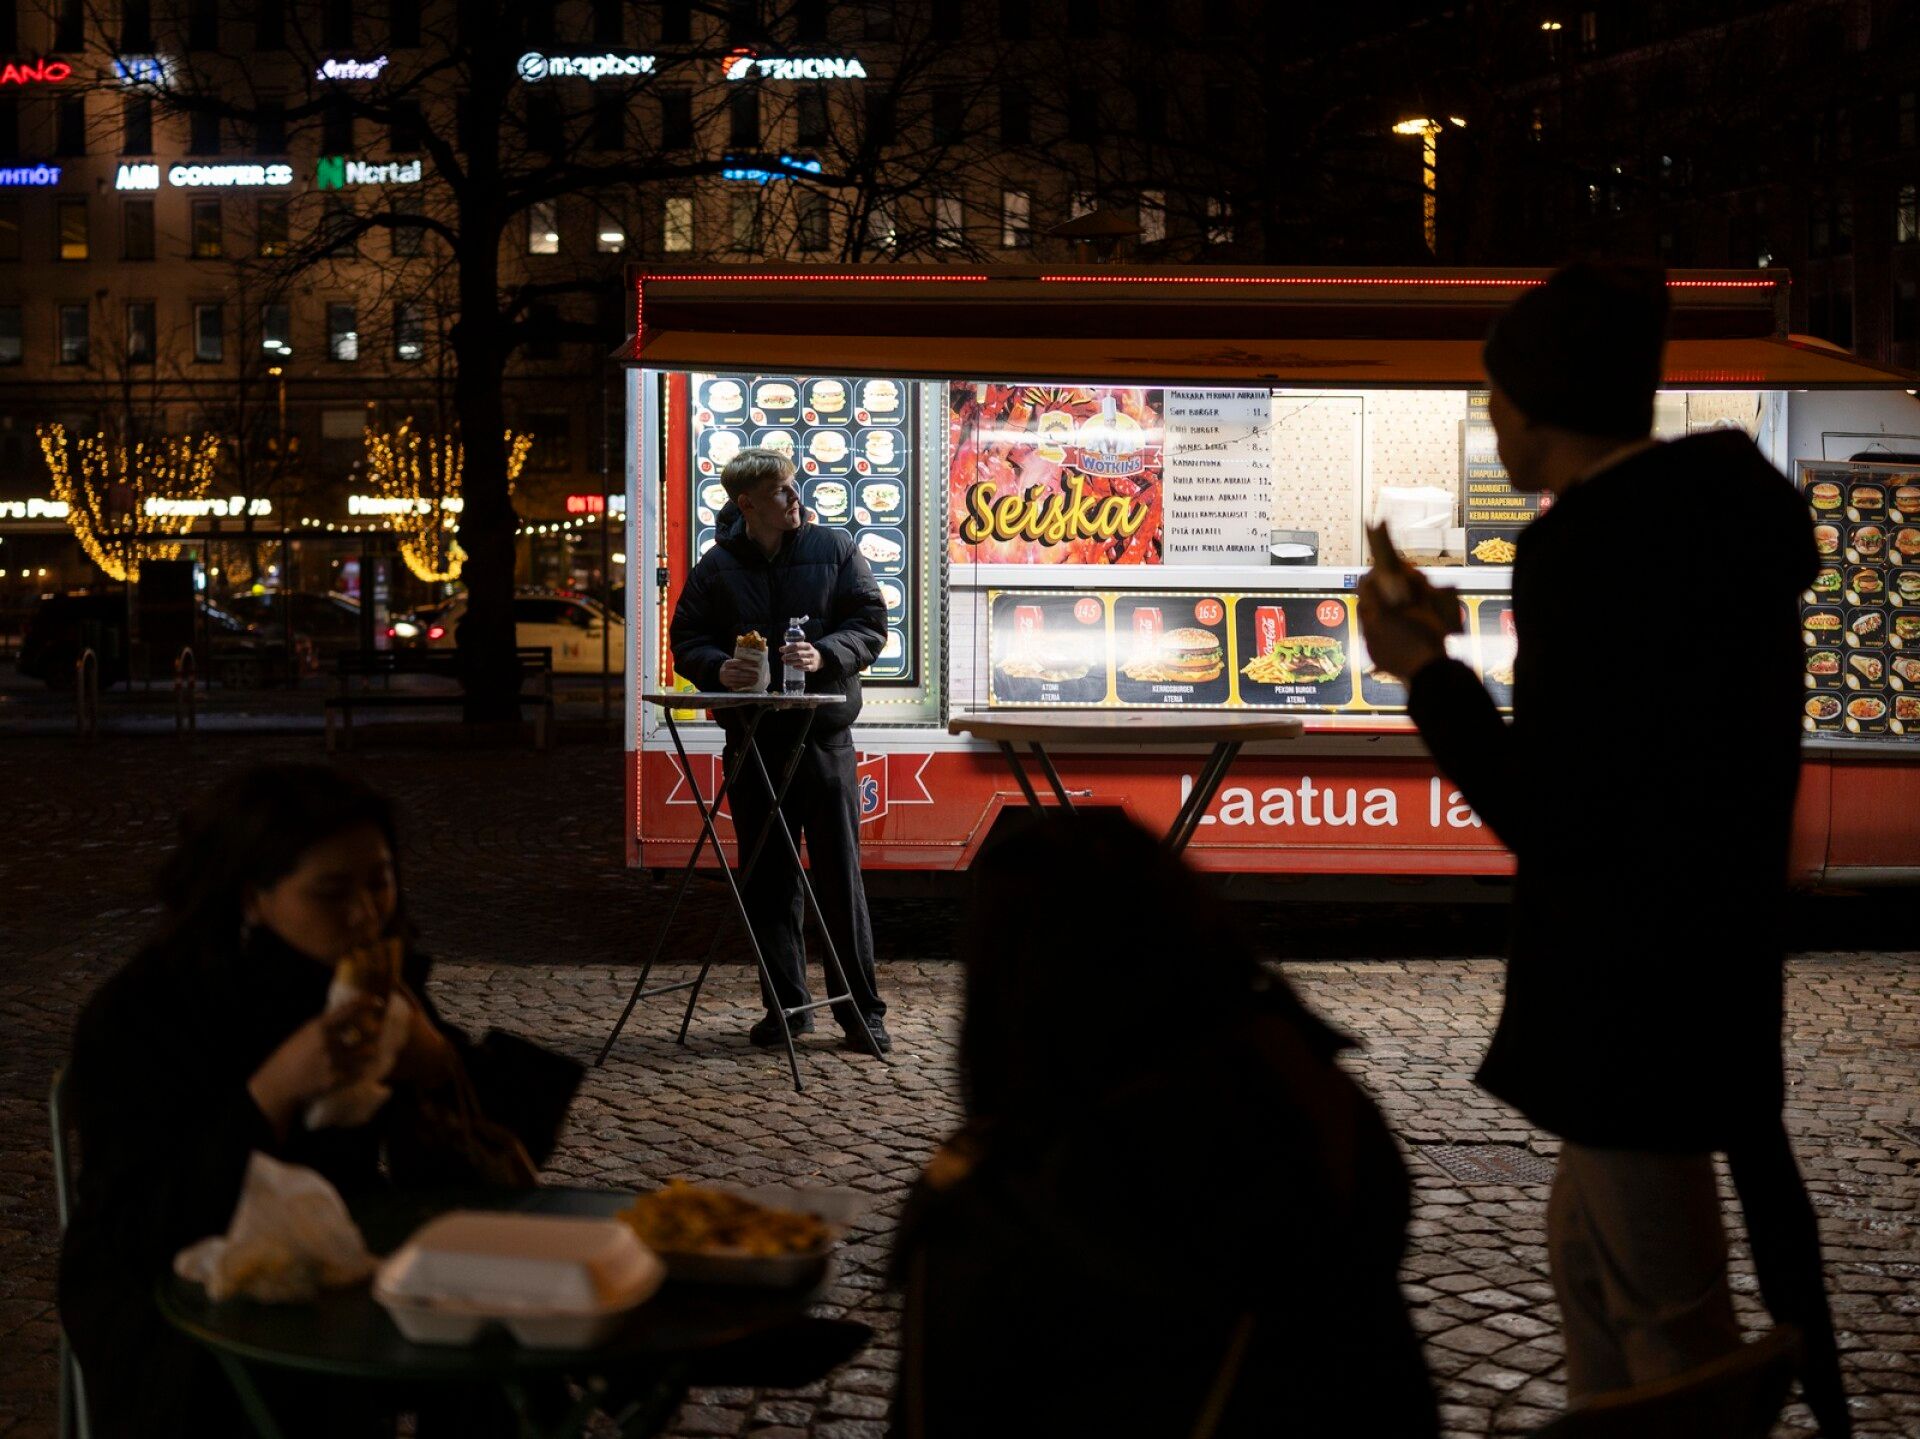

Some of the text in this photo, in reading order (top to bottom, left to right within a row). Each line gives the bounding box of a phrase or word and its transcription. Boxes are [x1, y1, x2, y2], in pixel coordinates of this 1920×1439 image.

[549, 54, 656, 80] mapbox
[346, 160, 421, 184] Nortal
[961, 474, 1148, 546] Seiska
[1180, 774, 1399, 827] Laatua
